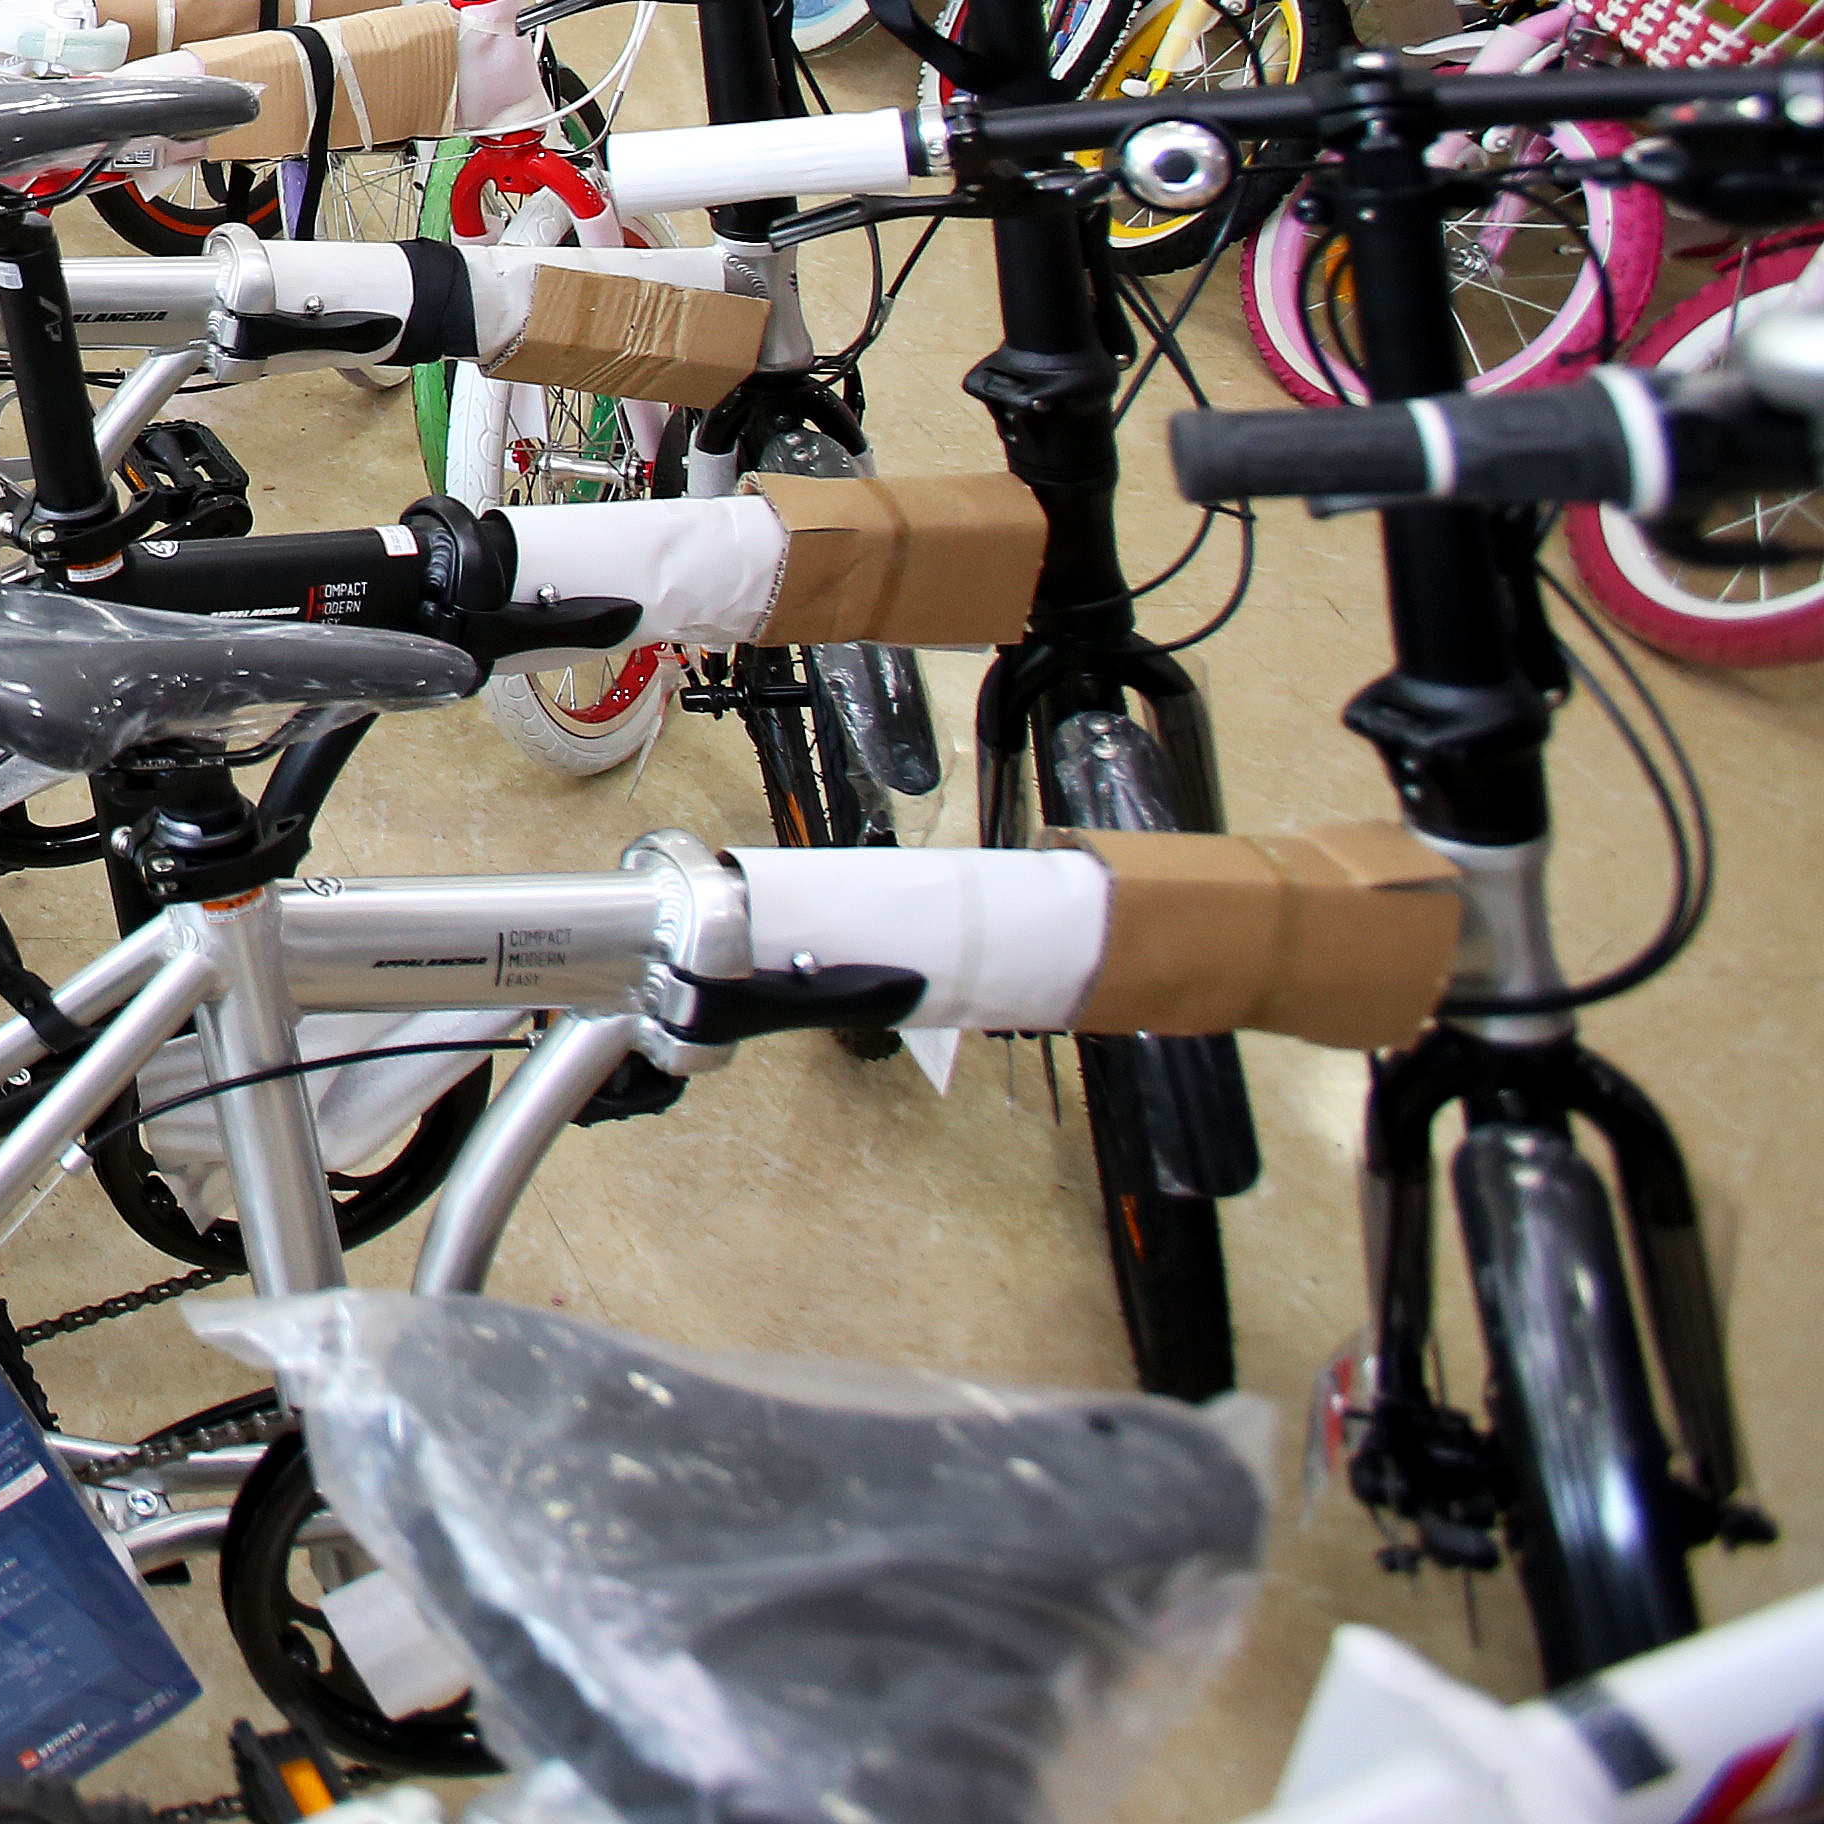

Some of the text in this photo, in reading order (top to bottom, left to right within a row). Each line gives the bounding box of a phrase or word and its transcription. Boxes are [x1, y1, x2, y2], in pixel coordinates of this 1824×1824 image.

[317, 581, 368, 598] COMPACT
[317, 600, 361, 617] MODERN
[508, 928, 573, 947] COMPACT
[372, 956, 489, 969] APPALANCHIA
[507, 950, 567, 967] MODERN
[505, 971, 541, 988] EASY
